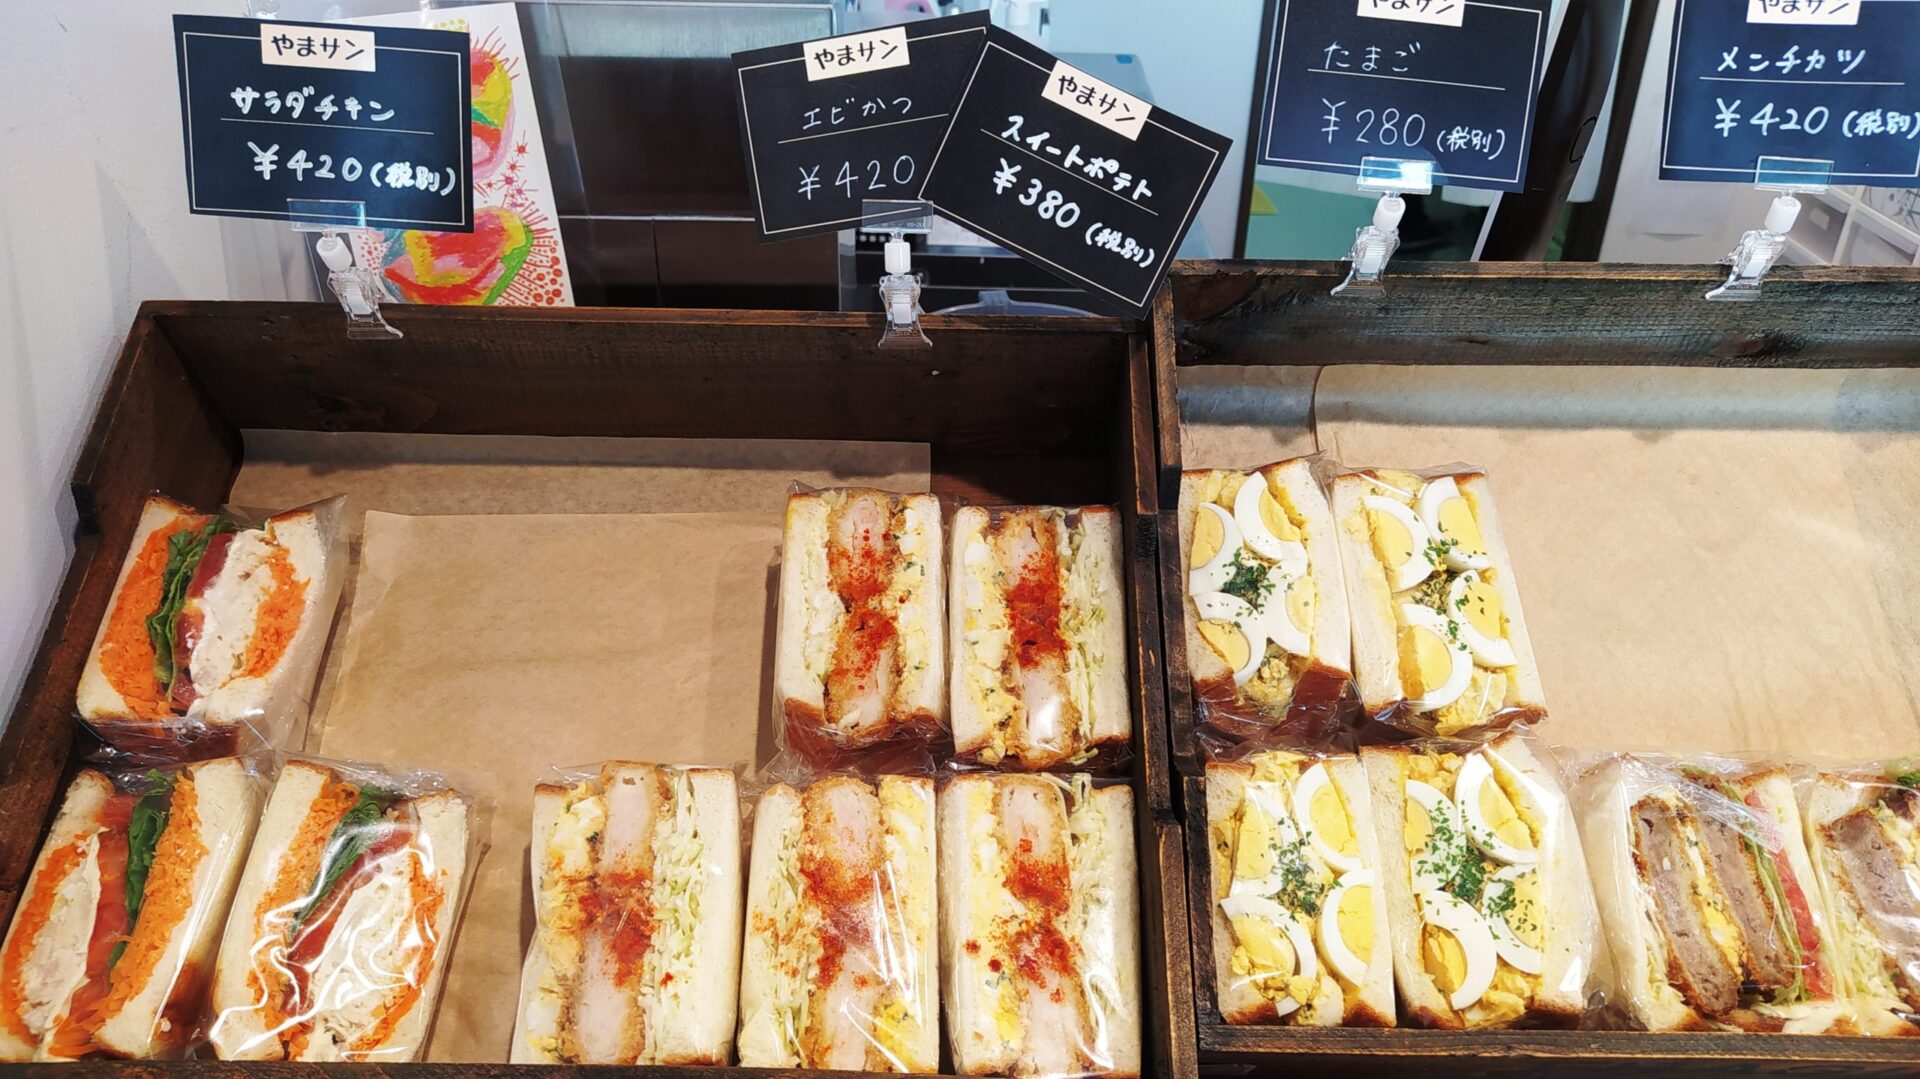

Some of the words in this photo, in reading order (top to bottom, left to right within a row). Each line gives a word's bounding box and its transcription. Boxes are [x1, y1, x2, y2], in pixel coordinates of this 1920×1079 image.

[270, 33, 365, 61] やまサン
[813, 39, 898, 70] やまサン
[1324, 41, 1421, 72] たまご
[1717, 45, 1866, 74] メンチカツ
[230, 86, 395, 122] サラダチキン
[802, 97, 912, 130] エビかつ
[1058, 75, 1136, 122] やまサン
[1001, 115, 1152, 200] スイートポテト
[797, 155, 915, 201] ¥420
